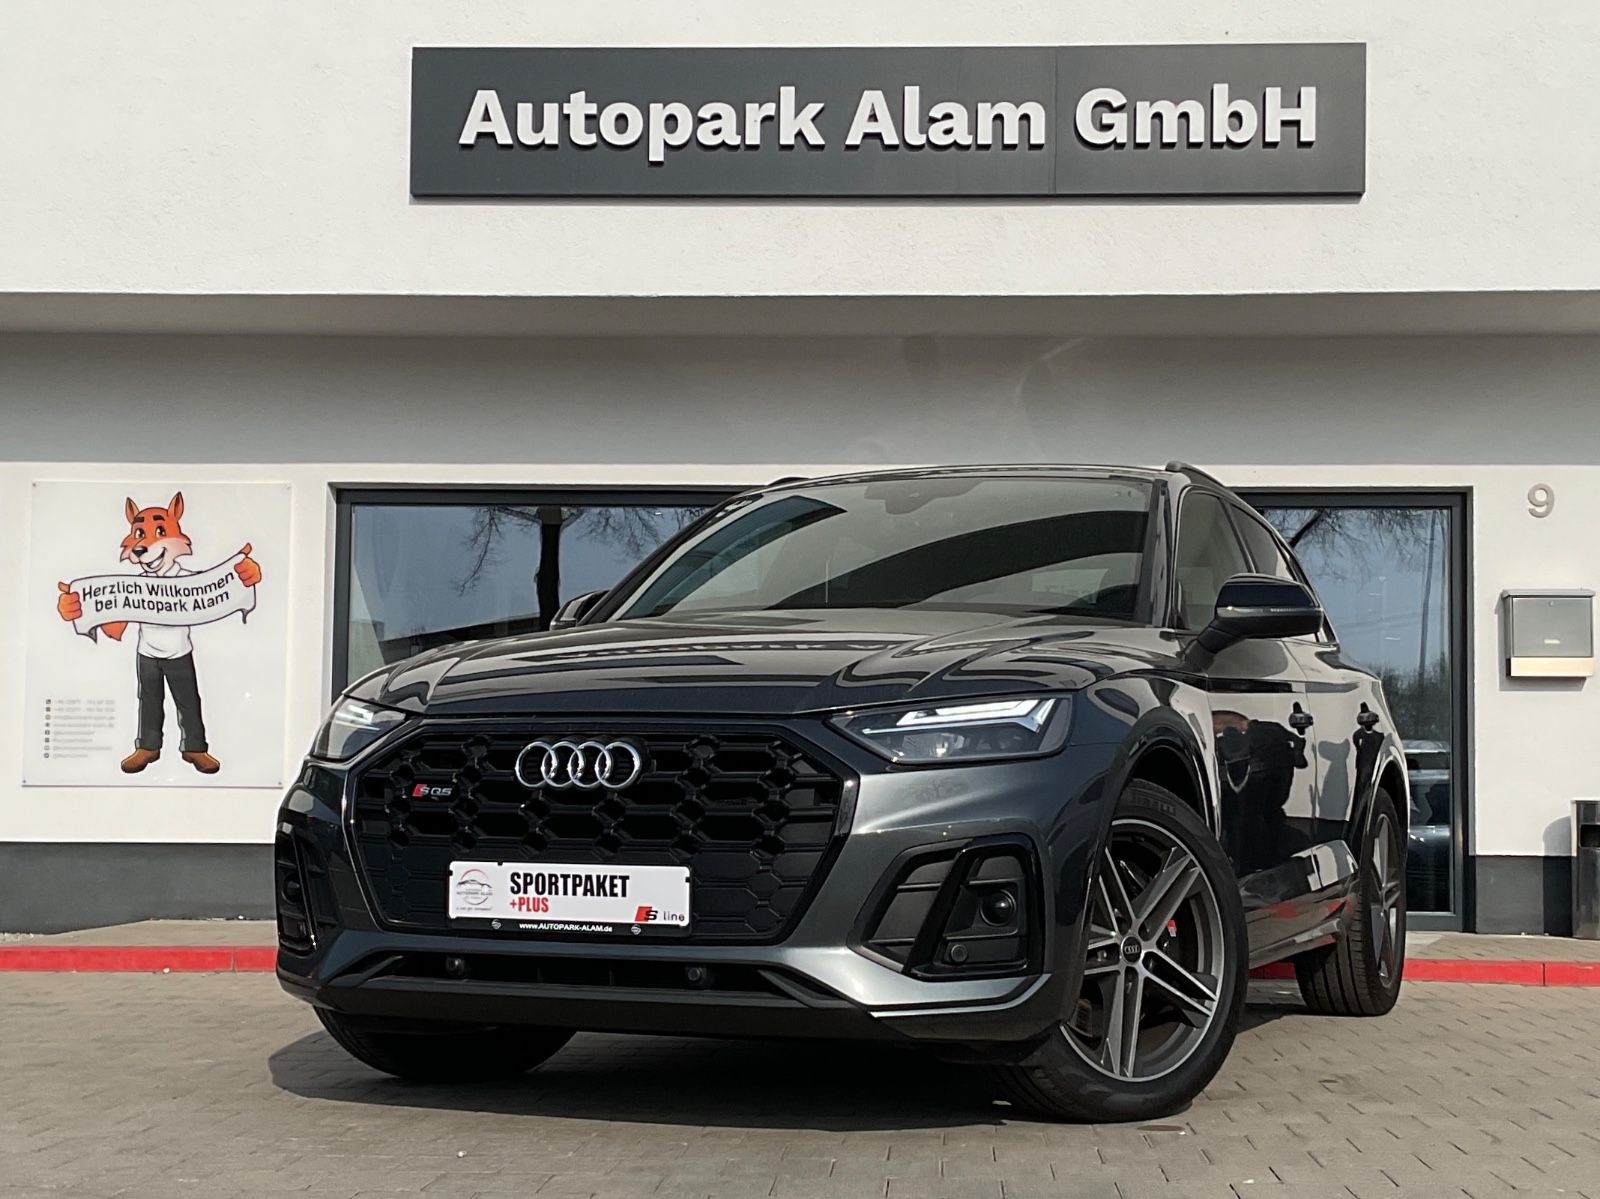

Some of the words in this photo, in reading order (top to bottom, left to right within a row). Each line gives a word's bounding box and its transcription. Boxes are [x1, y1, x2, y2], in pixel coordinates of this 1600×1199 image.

[459, 87, 826, 162] Autopark
[845, 85, 1046, 146] Alam
[1075, 83, 1317, 145] GmbH
[1527, 483, 1555, 519] 9
[82, 581, 142, 602] Herzlich
[146, 571, 235, 598] Willkommen
[95, 595, 118, 613] bei
[122, 595, 188, 614] Autopark
[193, 590, 230, 612] Alam
[510, 872, 630, 898] SPORTPAKET
[509, 896, 550, 913] +PLUS
[663, 910, 686, 922] line
[519, 922, 613, 933] www.AUTOPARK-ALAM.de
